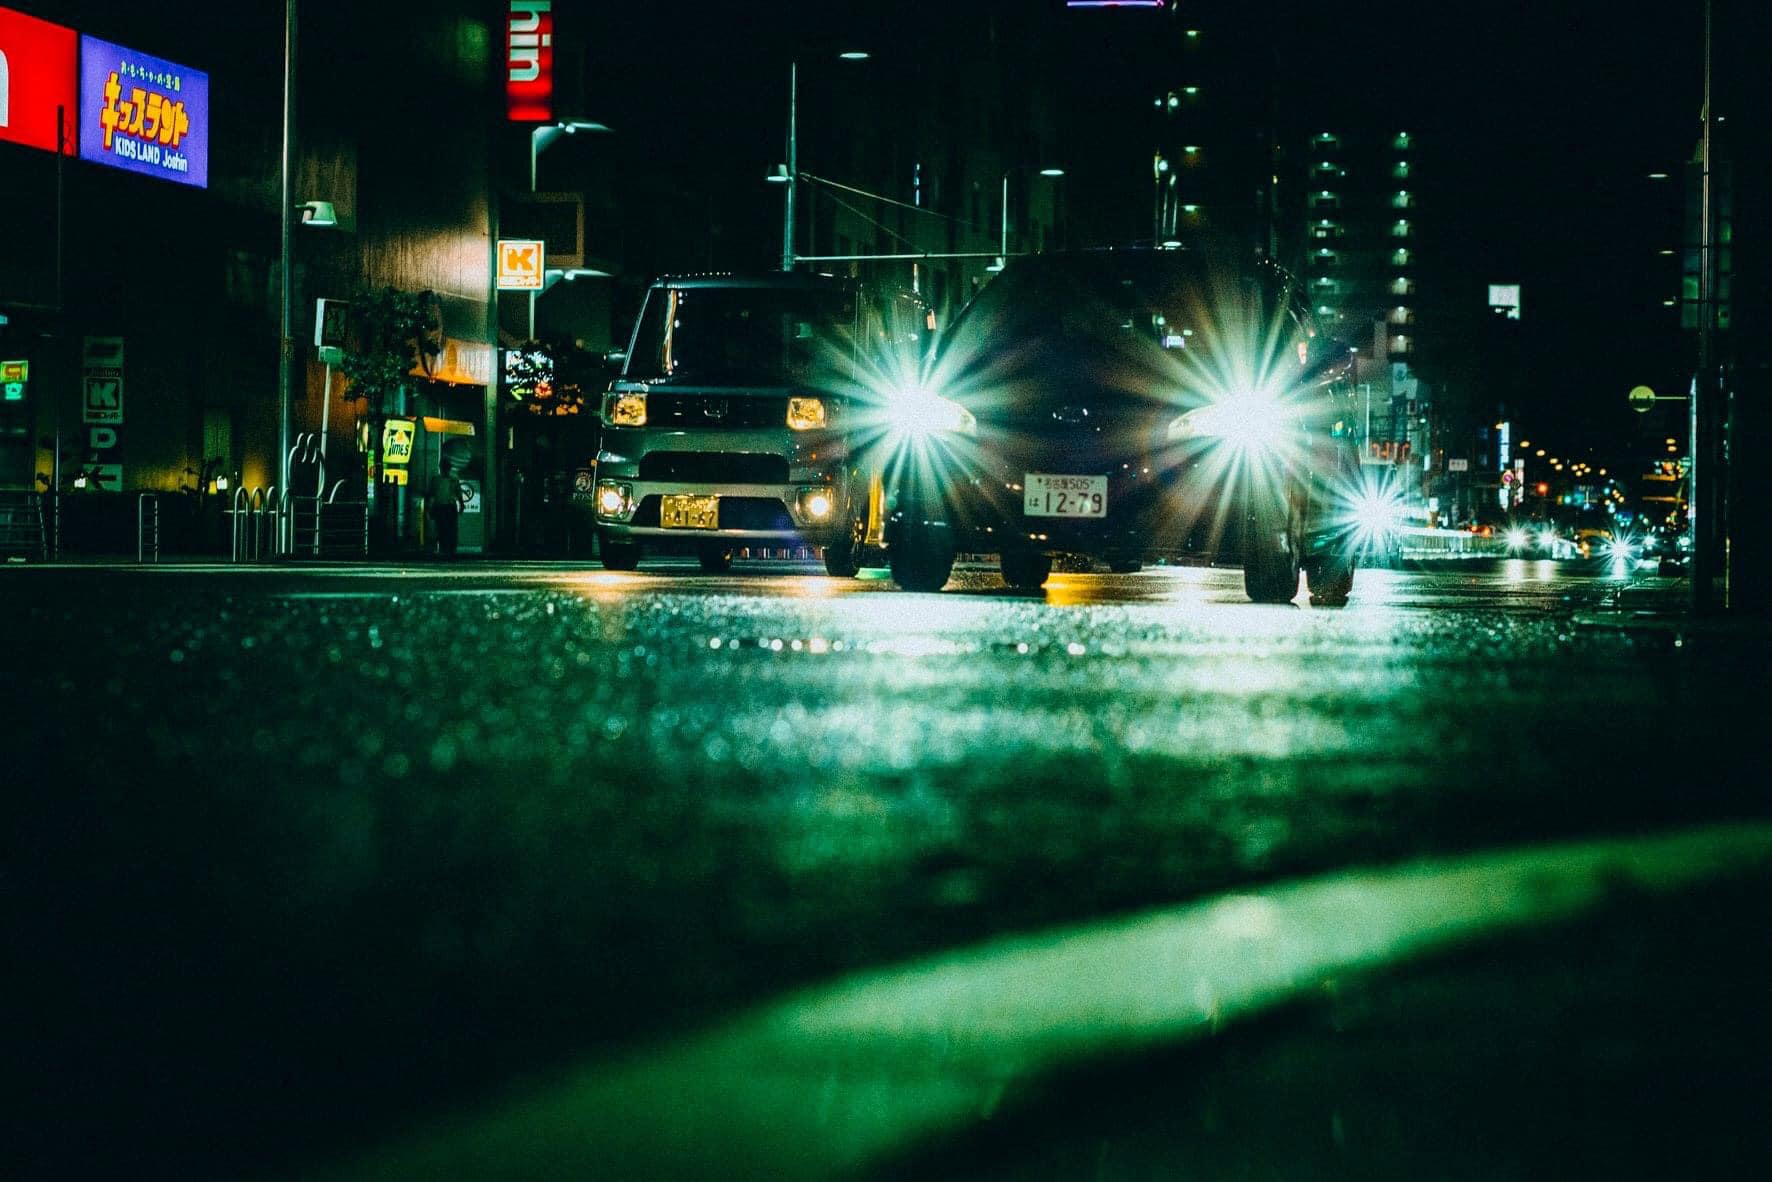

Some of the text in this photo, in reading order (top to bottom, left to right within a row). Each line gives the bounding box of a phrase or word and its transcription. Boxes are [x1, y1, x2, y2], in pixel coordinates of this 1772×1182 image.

[115, 136, 188, 172] KIDS LAND Joshin
[1045, 492, 1102, 513] 12-79
